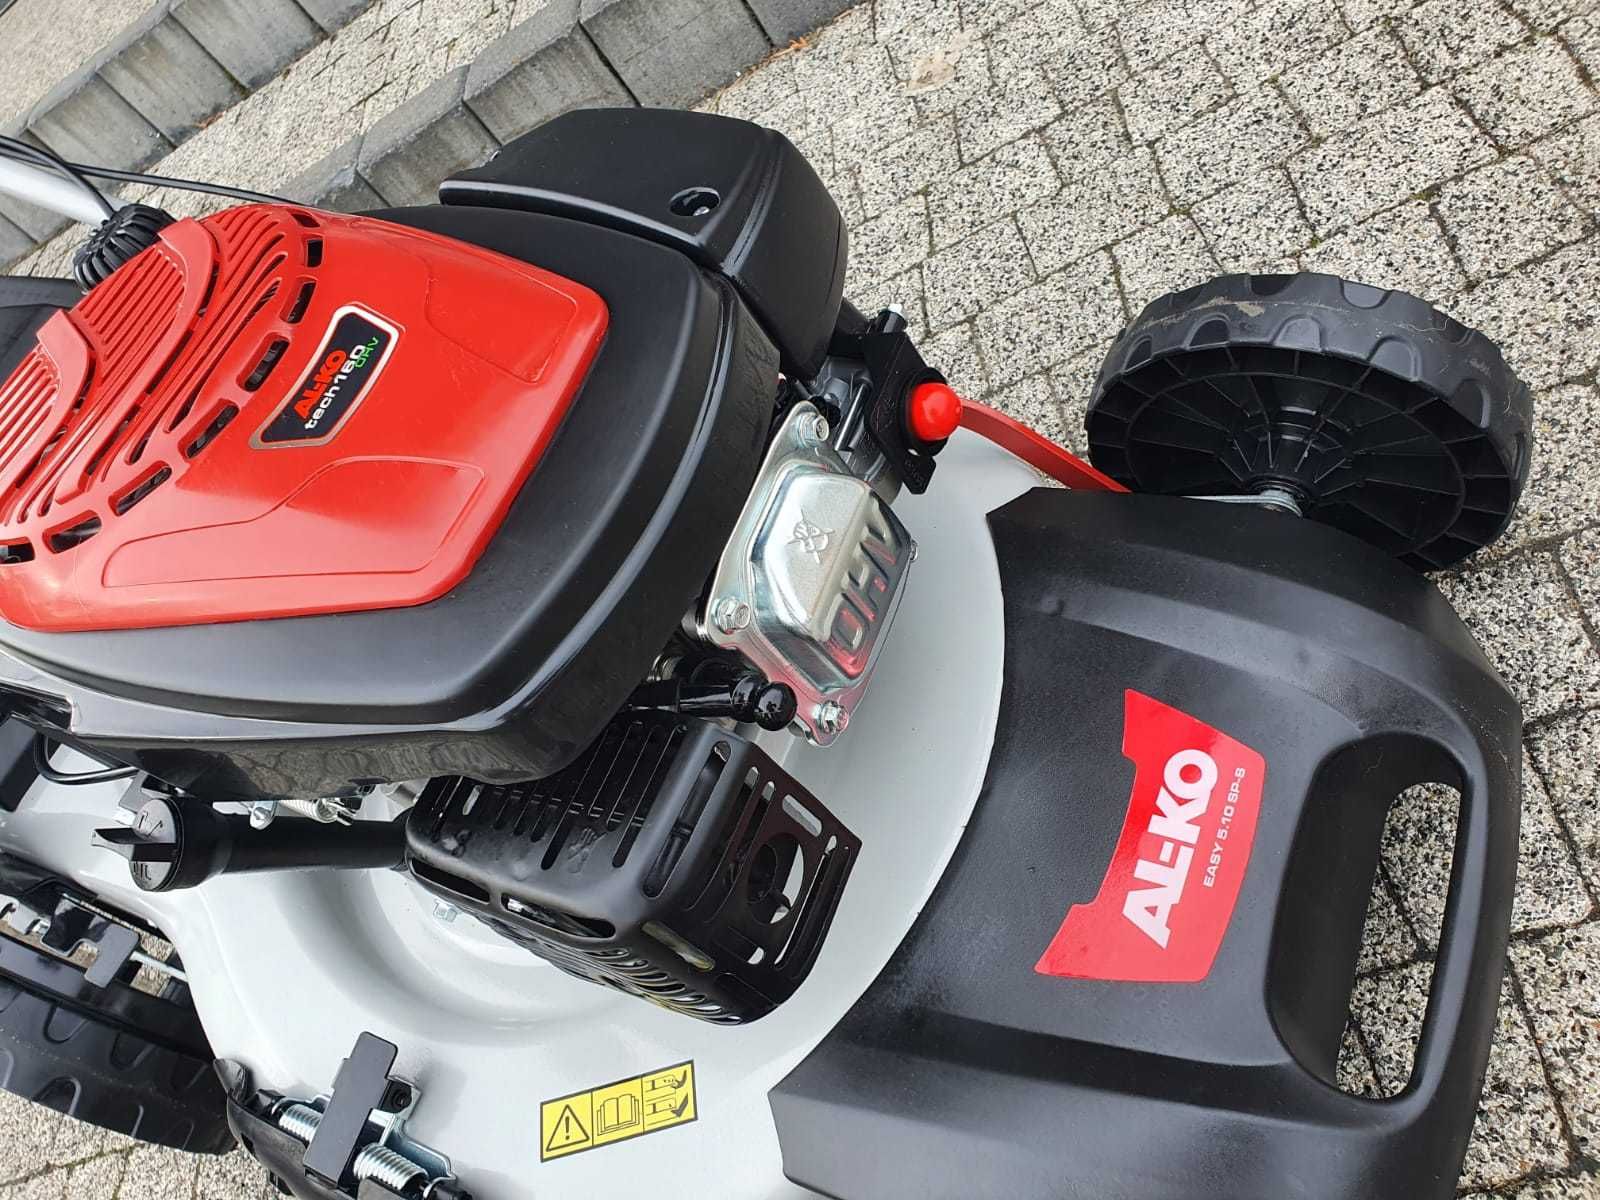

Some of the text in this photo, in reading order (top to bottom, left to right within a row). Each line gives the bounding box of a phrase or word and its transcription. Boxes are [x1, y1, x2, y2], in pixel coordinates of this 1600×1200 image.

[294, 350, 347, 418] AL-KO
[355, 337, 378, 368] OHV
[823, 497, 902, 677] OHV
[1122, 749, 1218, 949] AL-KO
[1203, 842, 1223, 887] EASY
[1216, 805, 1235, 840] 5.10
